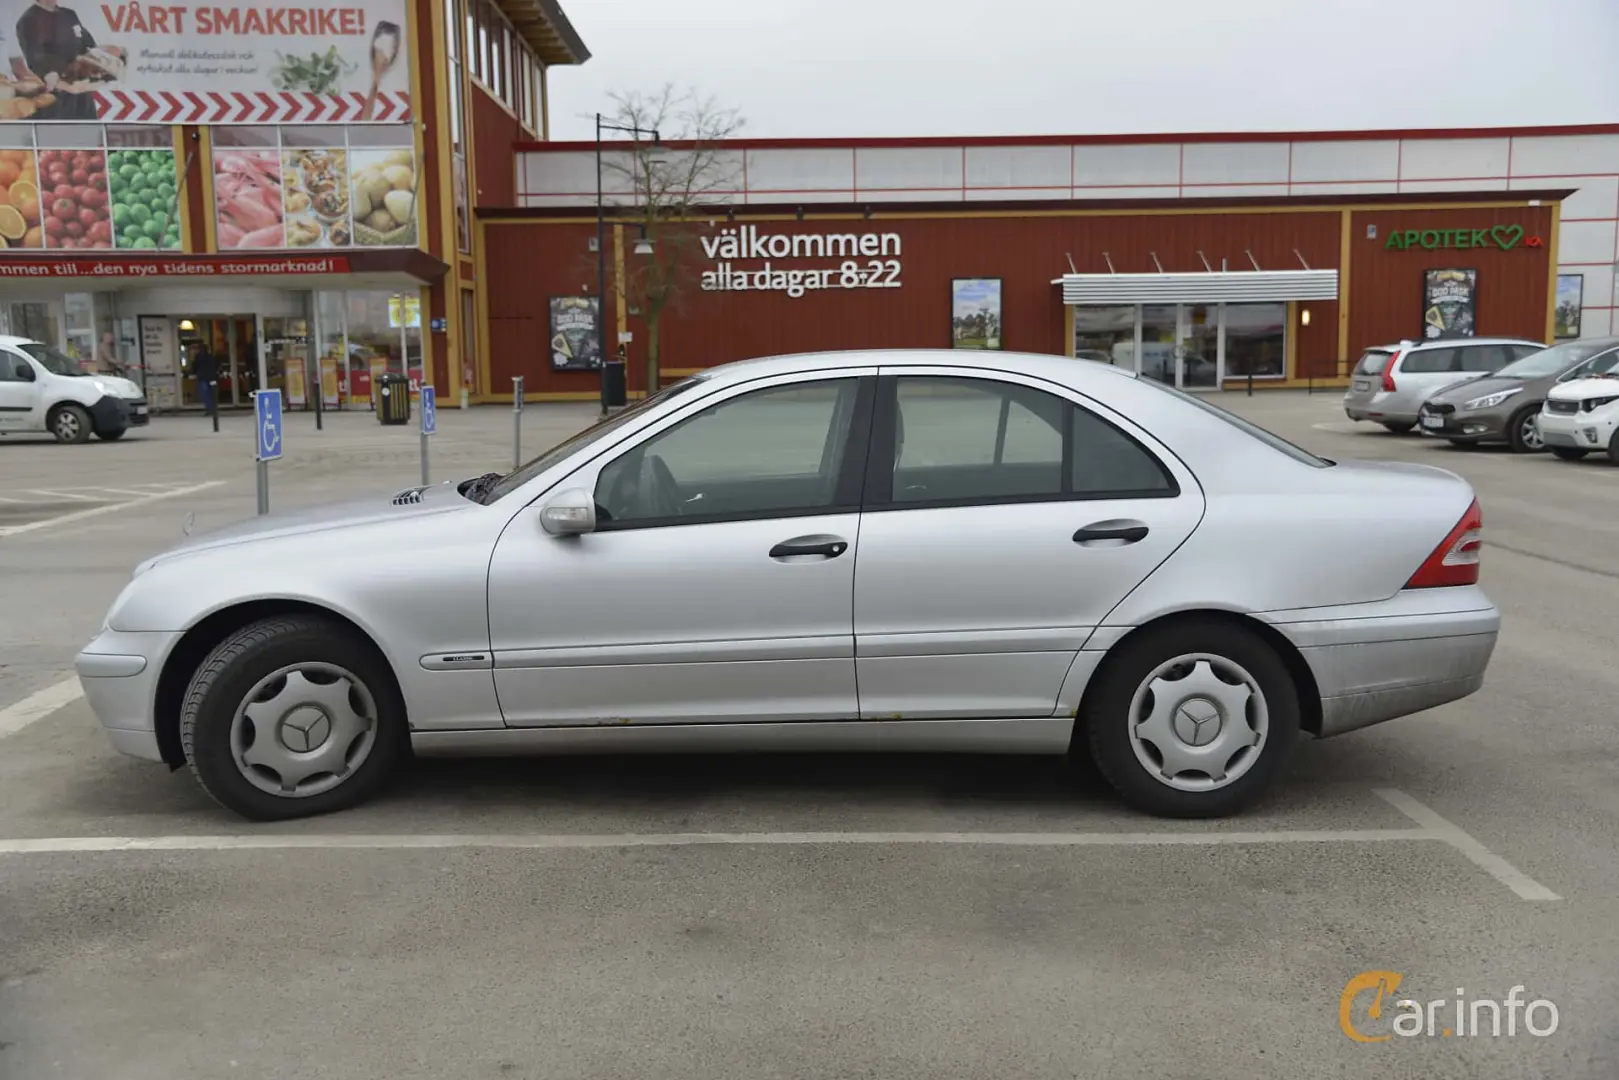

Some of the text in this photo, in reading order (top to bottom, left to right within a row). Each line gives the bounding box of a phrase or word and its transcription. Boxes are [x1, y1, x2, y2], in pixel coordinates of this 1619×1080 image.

[101, 1, 365, 36] VÅRT SMAKRIKE!
[700, 225, 901, 259] välkommen
[1384, 229, 1488, 249] APOTEK
[129, 265, 158, 277] nya
[163, 263, 215, 274] tidens
[220, 260, 334, 274] stormarknad!
[701, 262, 748, 290] alla
[753, 262, 833, 298] dagar
